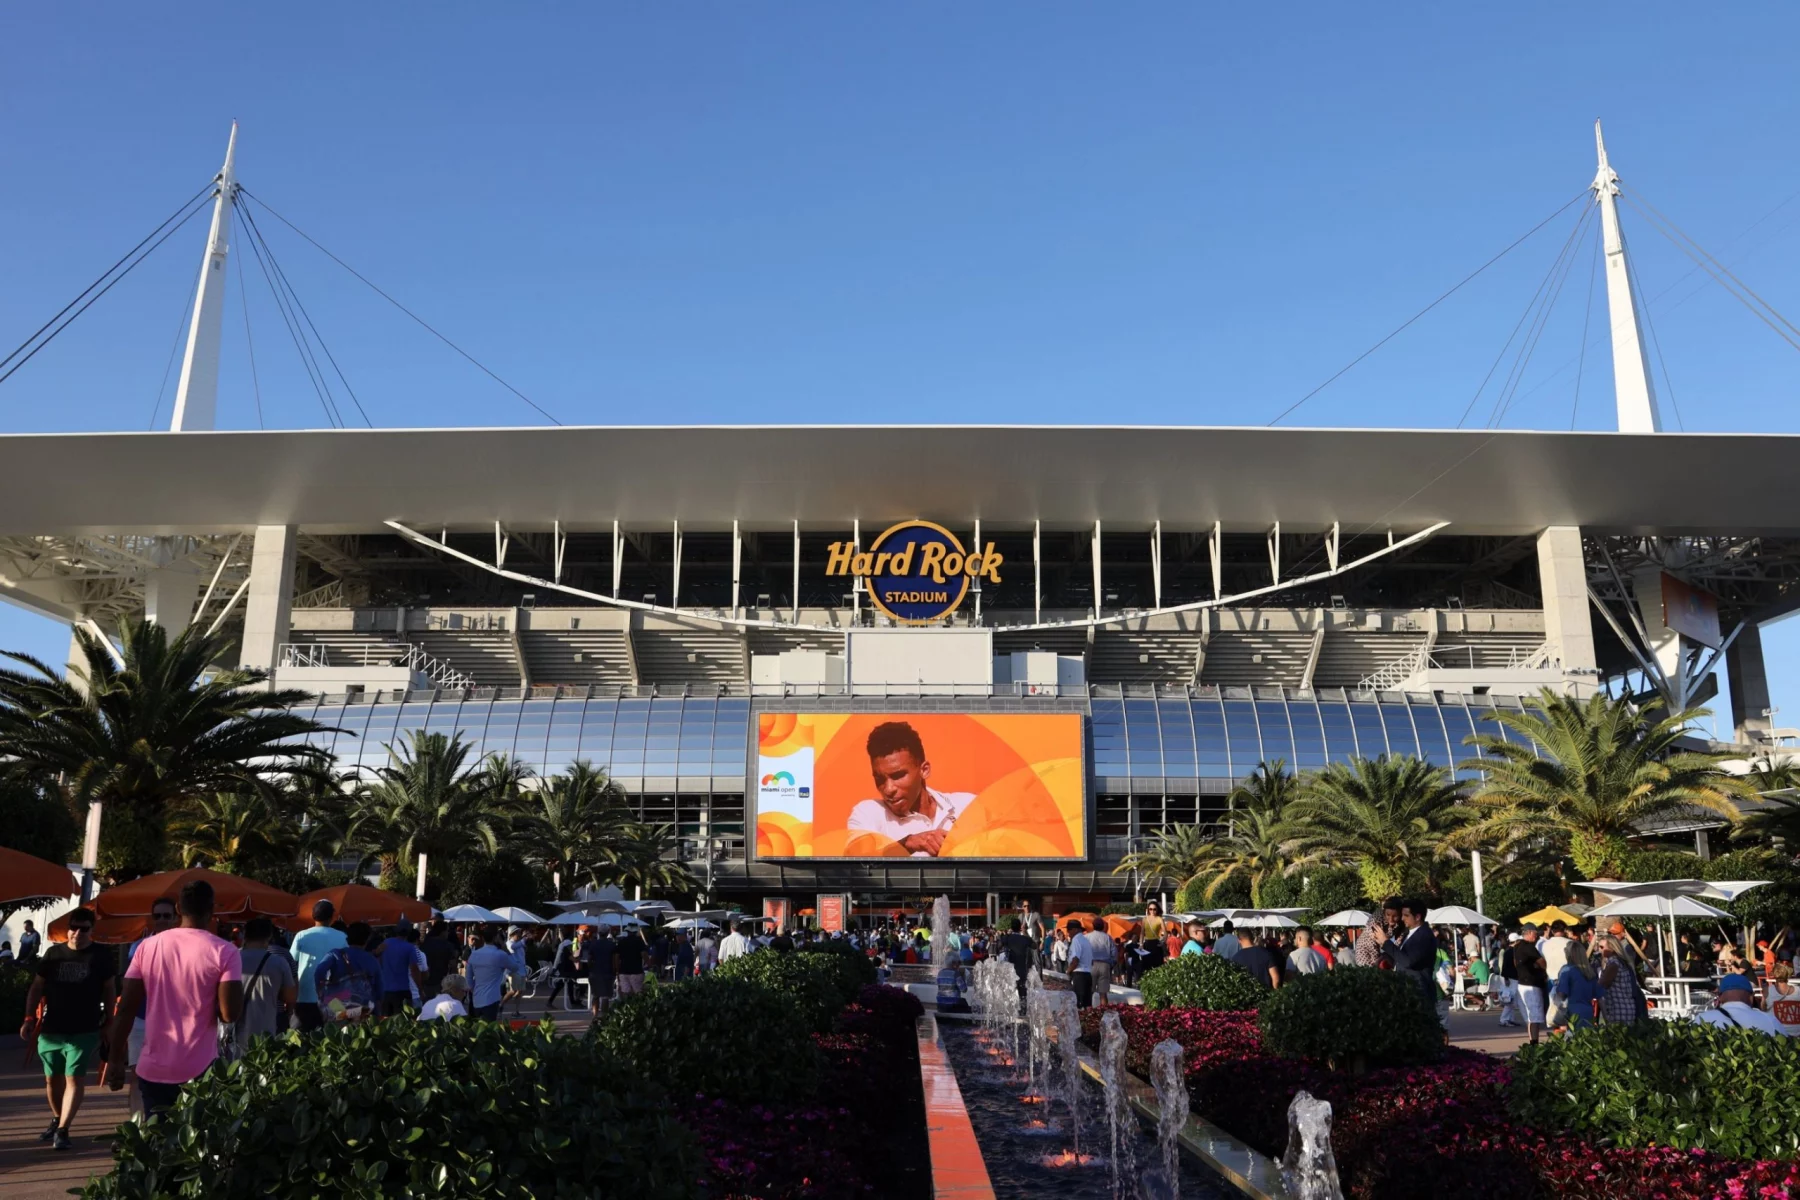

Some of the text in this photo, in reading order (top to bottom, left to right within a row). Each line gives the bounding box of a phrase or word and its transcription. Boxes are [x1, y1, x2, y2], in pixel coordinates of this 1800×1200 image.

[825, 541, 1003, 583] Hard Rock
[885, 591, 947, 603] STADIUM
